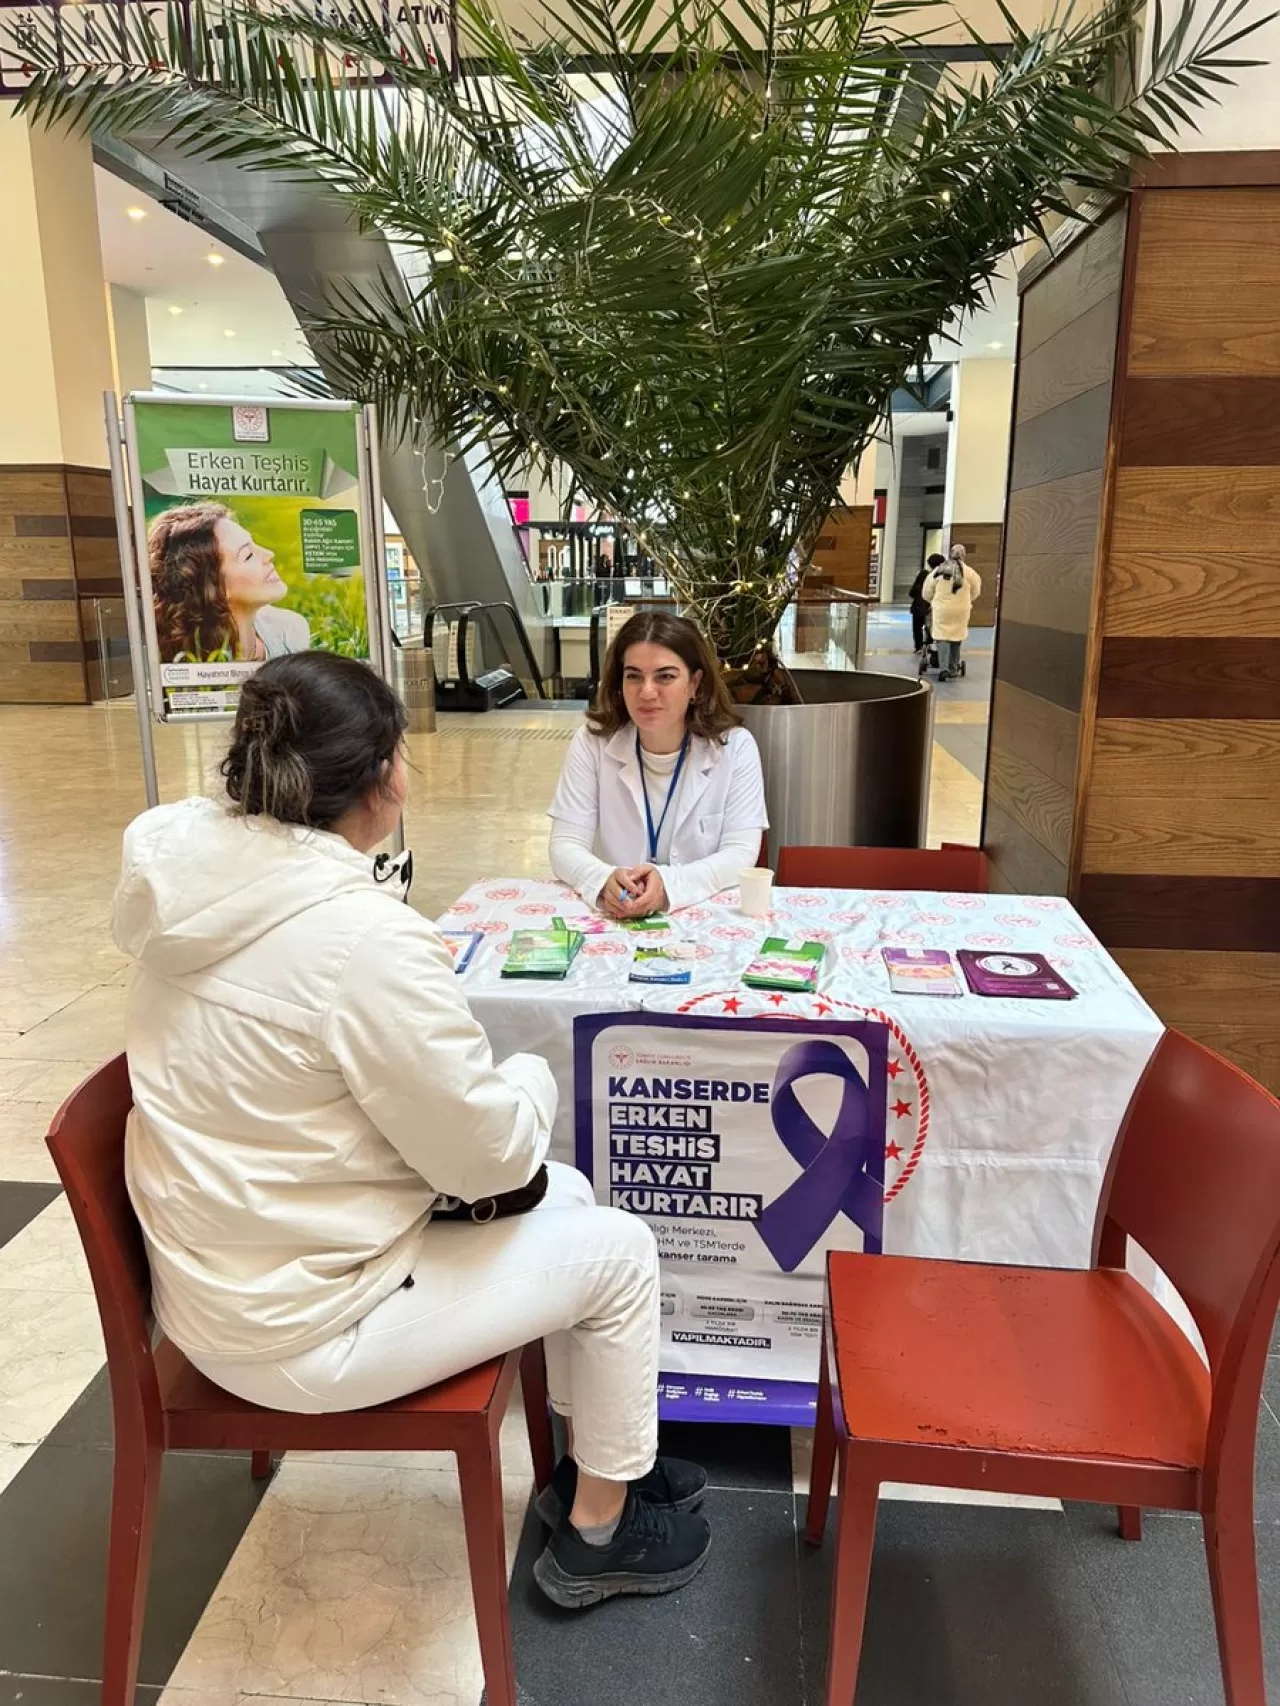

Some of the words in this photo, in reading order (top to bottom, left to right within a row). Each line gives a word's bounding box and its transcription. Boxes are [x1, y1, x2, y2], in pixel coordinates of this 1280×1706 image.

[397, 5, 445, 24] ATM
[187, 452, 244, 470] Erken
[250, 454, 310, 474] Teşhis
[188, 473, 238, 493] Hayat
[242, 475, 311, 492] Kurtarır.
[609, 1076, 769, 1103] KANSERDE
[611, 1105, 708, 1128] ERKEN
[611, 1162, 709, 1188] HAYAT
[612, 1189, 758, 1218] KURTARIR
[672, 1225, 717, 1238] Merkezi,
[678, 1240, 691, 1248] ve
[658, 1249, 694, 1260] kanser
[697, 1253, 737, 1263] tarama
[673, 1333, 770, 1347] YAPILMAKTADIR.
